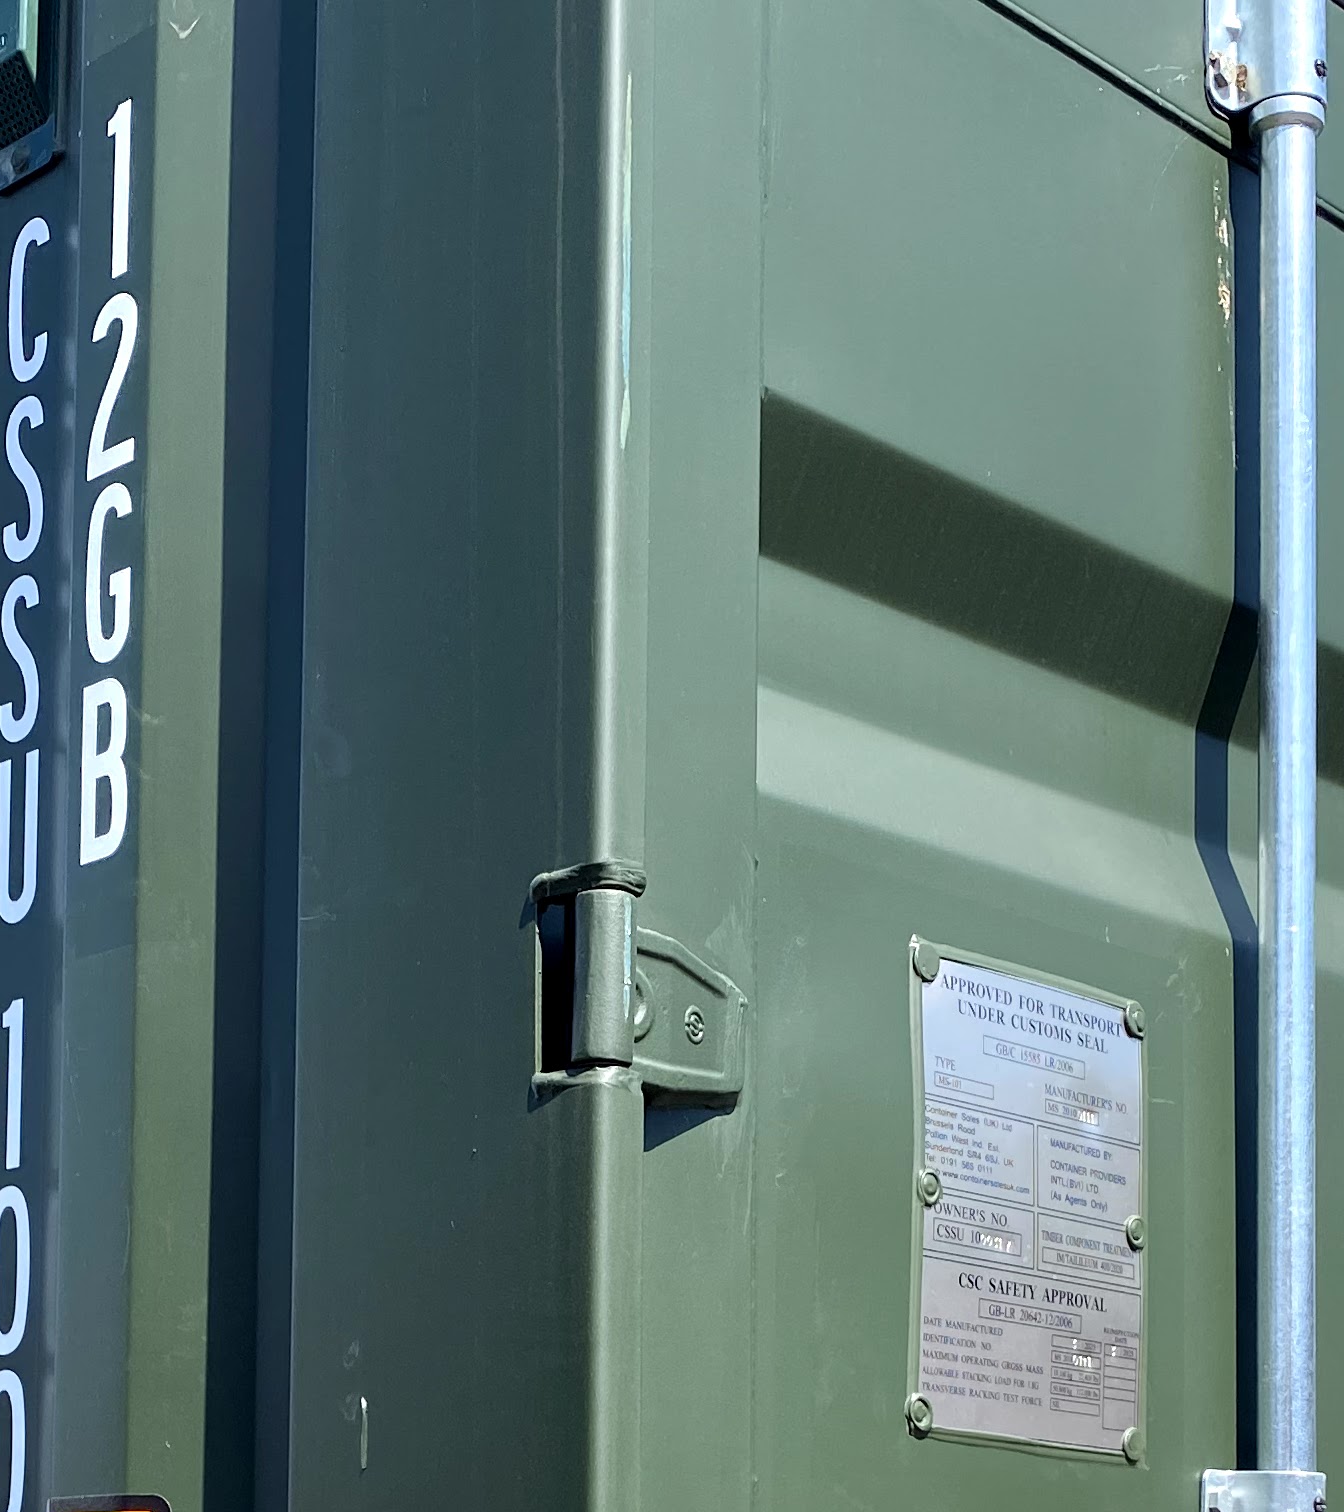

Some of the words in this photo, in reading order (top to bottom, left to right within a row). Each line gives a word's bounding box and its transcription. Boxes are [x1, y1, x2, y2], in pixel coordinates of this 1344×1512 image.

[80, 98, 138, 866] 12GB
[940, 973, 1013, 1006] APPROVED
[1019, 994, 1045, 1016] FOR
[1049, 1003, 1122, 1037] TRANSPORT
[958, 998, 1006, 1026] UNDER
[1011, 1013, 1072, 1043] CUSTOMS
[1077, 1031, 1109, 1054] SEAL
[935, 1055, 956, 1071] TYPE
[1044, 1083, 1113, 1111] MANUFACTURER'S
[1048, 1101, 1059, 1113] MS
[925, 1104, 958, 1119] Container
[961, 1112, 981, 1125] Sales
[984, 1117, 999, 1129] (UK)
[1002, 1122, 1013, 1133] Ltd
[925, 1116, 954, 1131] Brussels
[958, 1123, 976, 1136] Road
[952, 1134, 969, 1146] West
[1050, 1137, 1101, 1159] MANUFACTURED
[925, 1140, 964, 1157] Sunderland
[967, 1149, 982, 1160] SR4
[1004, 1157, 1014, 1168] UK
[941, 1156, 957, 1167] 0191
[978, 1164, 993, 1174] 0111
[1050, 1159, 1087, 1176] CONTAINER
[1090, 1168, 1127, 1186] PROVIDERS
[934, 1202, 986, 1222] OWNER'S
[1051, 1190, 1062, 1202] (As
[1065, 1194, 1087, 1207] Agents
[1090, 1199, 1108, 1214] Only)
[937, 1223, 965, 1242] CSSU
[1041, 1230, 1064, 1245] TIMBER
[1065, 1235, 1100, 1251] COMPONENT
[1103, 1242, 1135, 1259] TREATMENT
[958, 1271, 984, 1291] CSC
[988, 1277, 1037, 1300] SAFETY
[1042, 1287, 1108, 1313] APPROVAL
[988, 1304, 1016, 1320] GB-LR
[923, 1315, 942, 1327] DATE
[945, 1319, 1004, 1337] MANUFACTURED
[922, 1332, 977, 1349] IDENTIFICATION
[922, 1349, 959, 1363] MAXIMUM
[961, 1354, 999, 1369] OPERATING
[1001, 1360, 1024, 1373] GROSS
[1026, 1364, 1044, 1375] MASS
[922, 1365, 959, 1379] ALLOWABLE
[962, 1371, 993, 1384] STACKING
[994, 1375, 1011, 1386] LOAD
[1013, 1378, 1025, 1388] FOR
[922, 1381, 966, 1396] TRANSVERSE
[969, 1388, 1001, 1401] RACKING
[1003, 1393, 1019, 1404] TEST
[1021, 1396, 1043, 1407] FORCE
